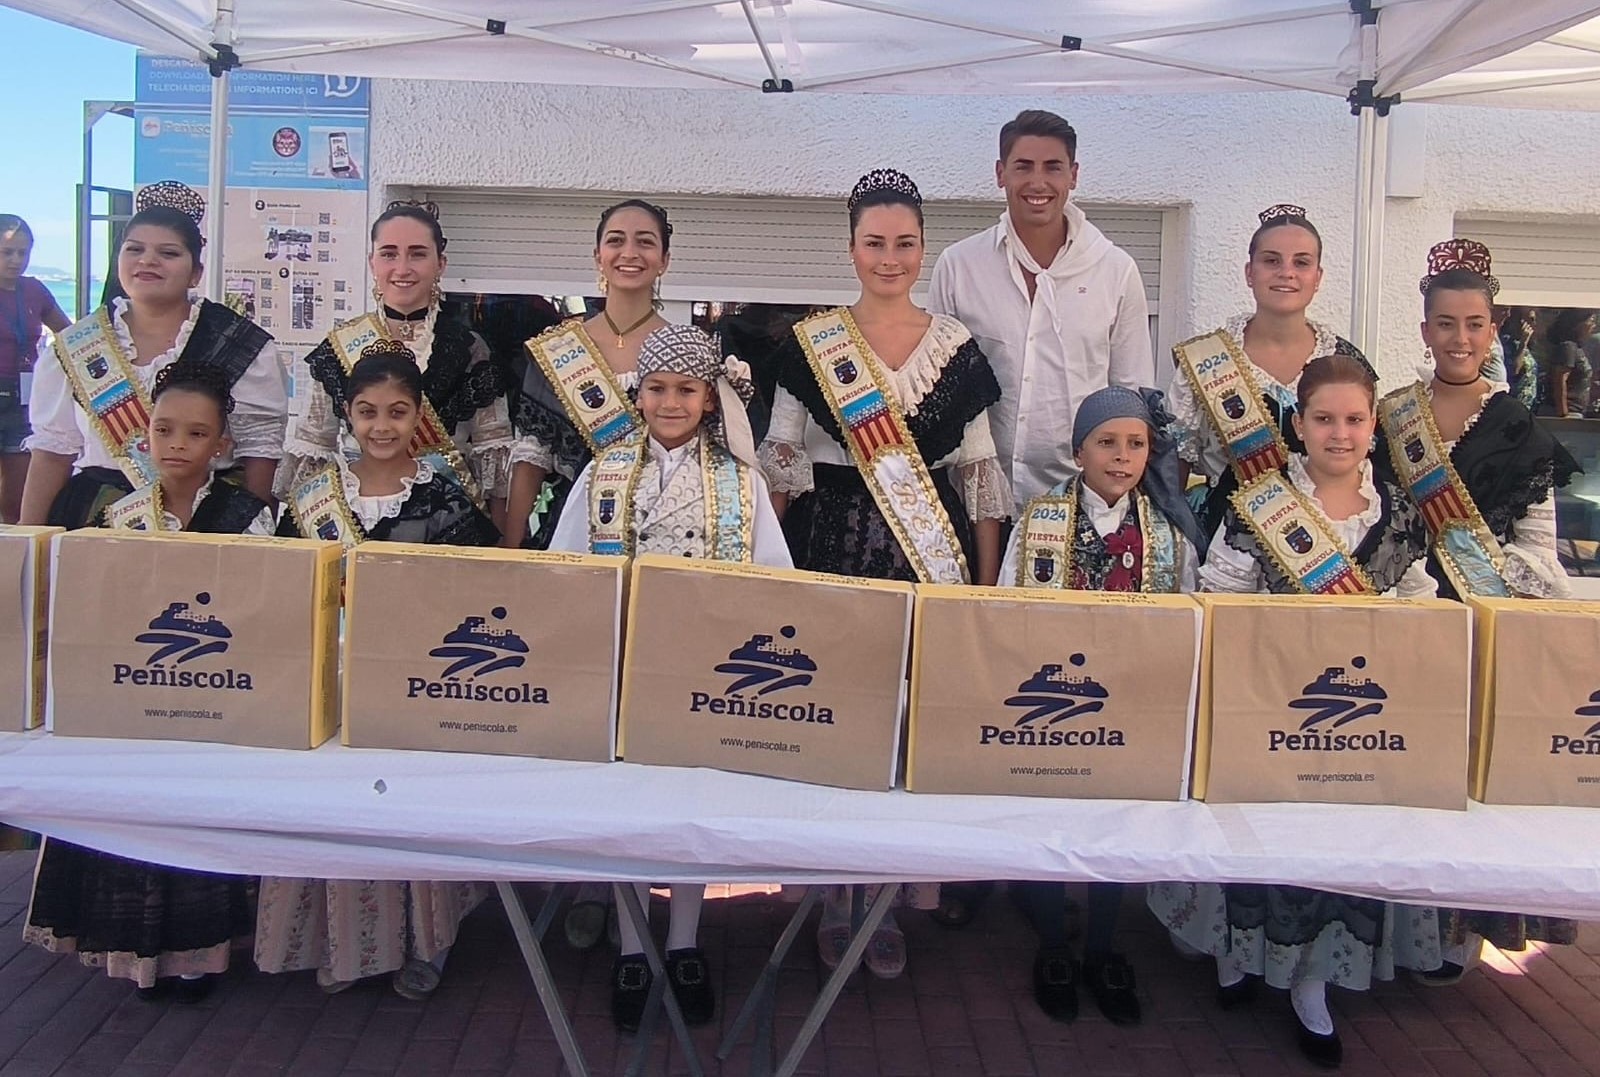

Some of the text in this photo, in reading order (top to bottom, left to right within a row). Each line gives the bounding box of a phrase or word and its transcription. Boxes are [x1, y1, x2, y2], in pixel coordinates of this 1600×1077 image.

[305, 87, 318, 95] ICI
[67, 323, 100, 344] 2024
[346, 329, 377, 353] 2024
[811, 323, 846, 344] 2024
[71, 336, 107, 359] FIESTAS
[553, 346, 586, 369] 2024
[817, 339, 854, 360] FIESTAS
[562, 362, 598, 385] FIESTAS
[1196, 351, 1230, 374] 2024
[1203, 370, 1240, 391] FIESTAS
[604, 450, 637, 462] 2024
[297, 474, 329, 502] 2024
[596, 473, 629, 482] FIESTAS
[113, 496, 152, 518] FIESTAS
[301, 493, 336, 520] FIESTAS
[1247, 483, 1284, 513] 2024
[1031, 507, 1067, 521] 2024
[1261, 500, 1299, 531] FIESTAS
[1027, 532, 1066, 543] FIESTAS
[113, 663, 253, 690] Peñíscola
[407, 677, 550, 704] Peñíscola
[144, 708, 223, 720] www.peniscola.es
[689, 691, 835, 725] Peñíscola
[439, 719, 518, 734] www.peniscola.es
[979, 725, 1126, 747] Peñíscola
[720, 736, 801, 753] www.peniscola.es
[1268, 728, 1407, 751] Peñíscola
[1010, 765, 1092, 776] www.peniscola.es
[1297, 772, 1375, 783] www.peniscola.es
